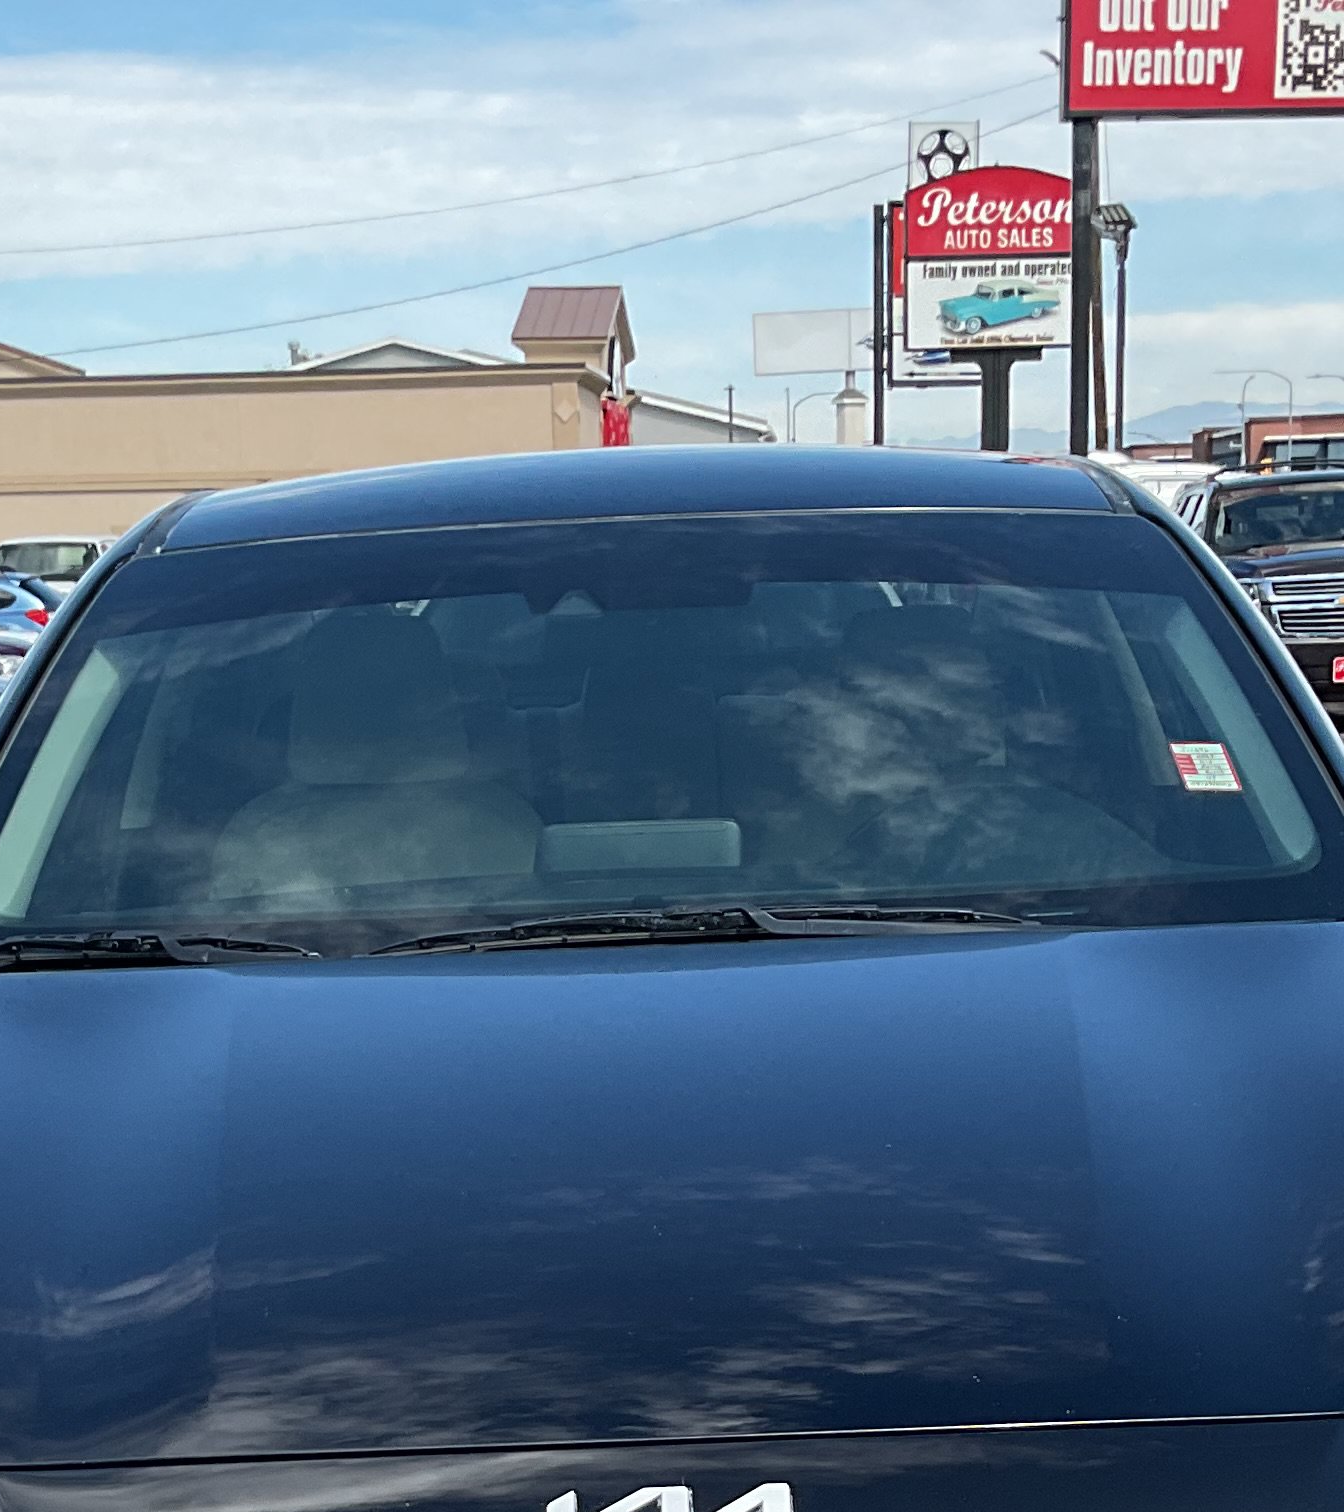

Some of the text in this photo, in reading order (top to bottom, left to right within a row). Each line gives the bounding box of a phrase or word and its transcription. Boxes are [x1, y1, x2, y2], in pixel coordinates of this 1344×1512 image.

[1099, 0, 1229, 32] Out Our
[1082, 40, 1243, 93] Inventory
[917, 187, 1072, 227] Peterson
[944, 227, 1054, 250] AUTO SALES
[923, 263, 957, 280] Family
[961, 262, 997, 278] owned
[1001, 261, 1021, 276] and
